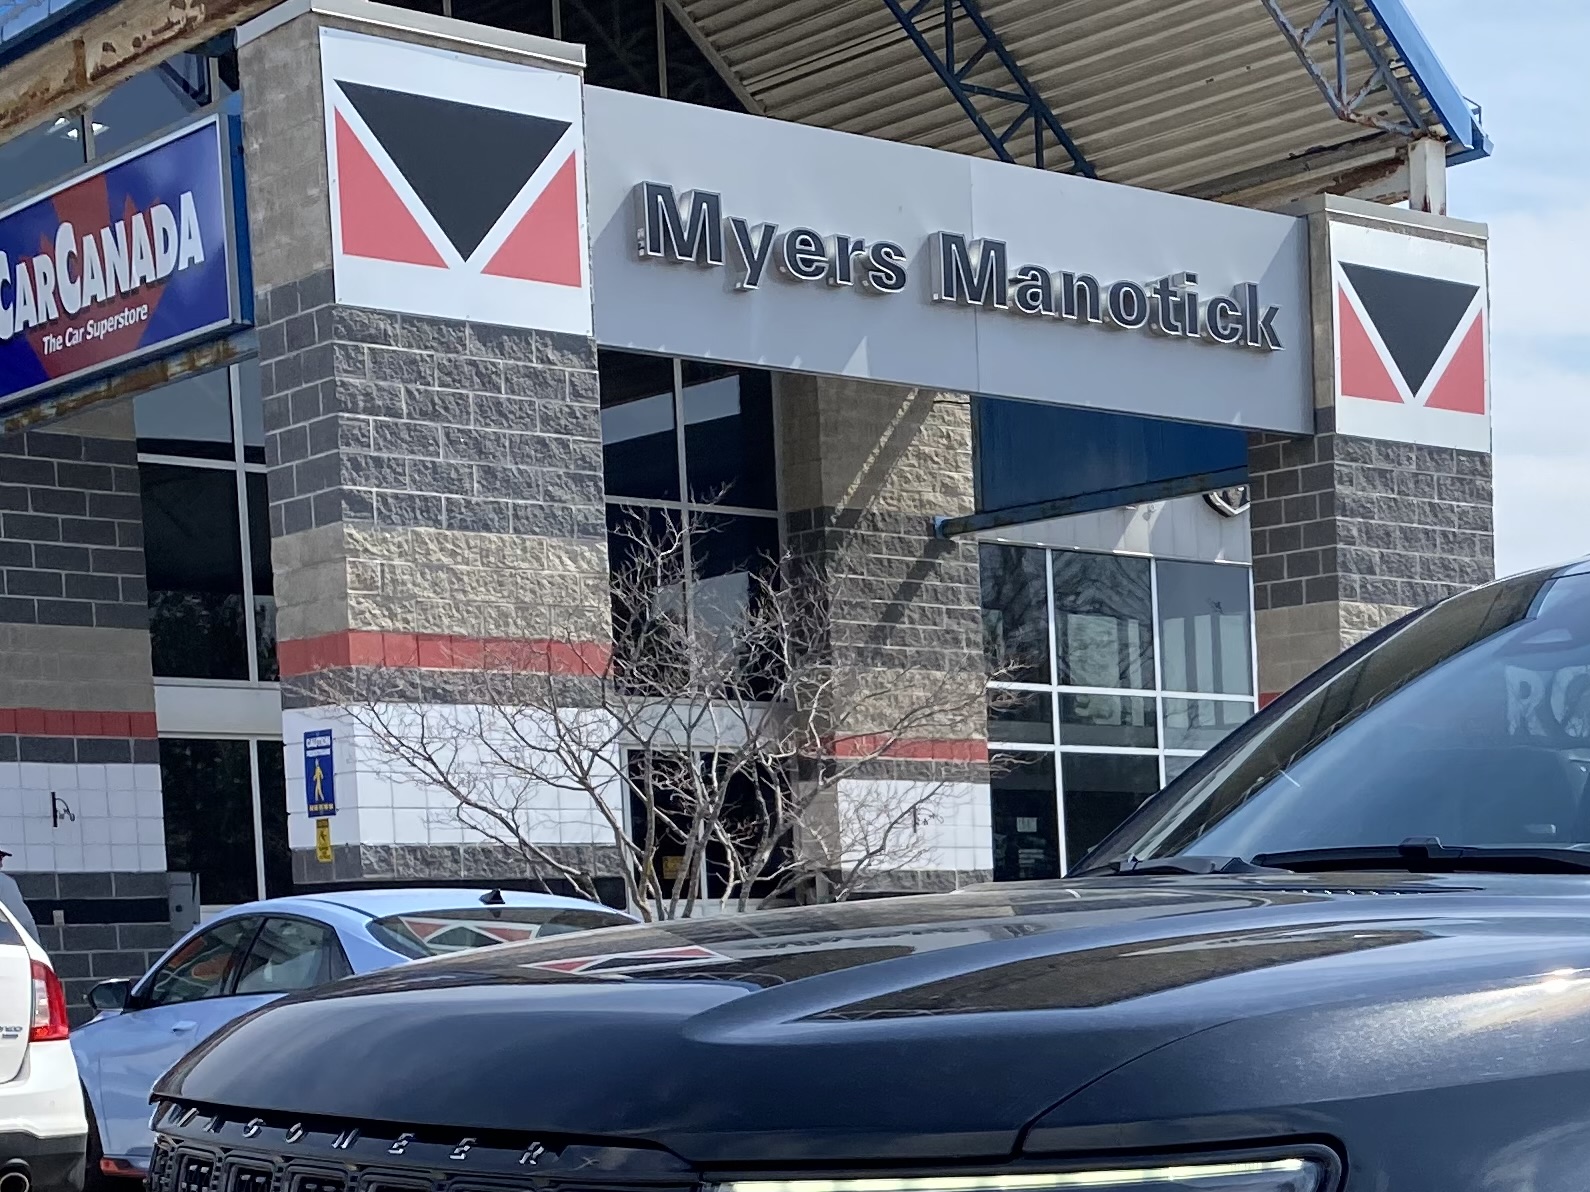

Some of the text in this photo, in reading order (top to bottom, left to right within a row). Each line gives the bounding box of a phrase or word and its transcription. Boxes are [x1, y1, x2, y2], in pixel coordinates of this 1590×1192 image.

[638, 180, 1285, 352] Myers Manotick
[42, 303, 149, 355] The Car Superstore
